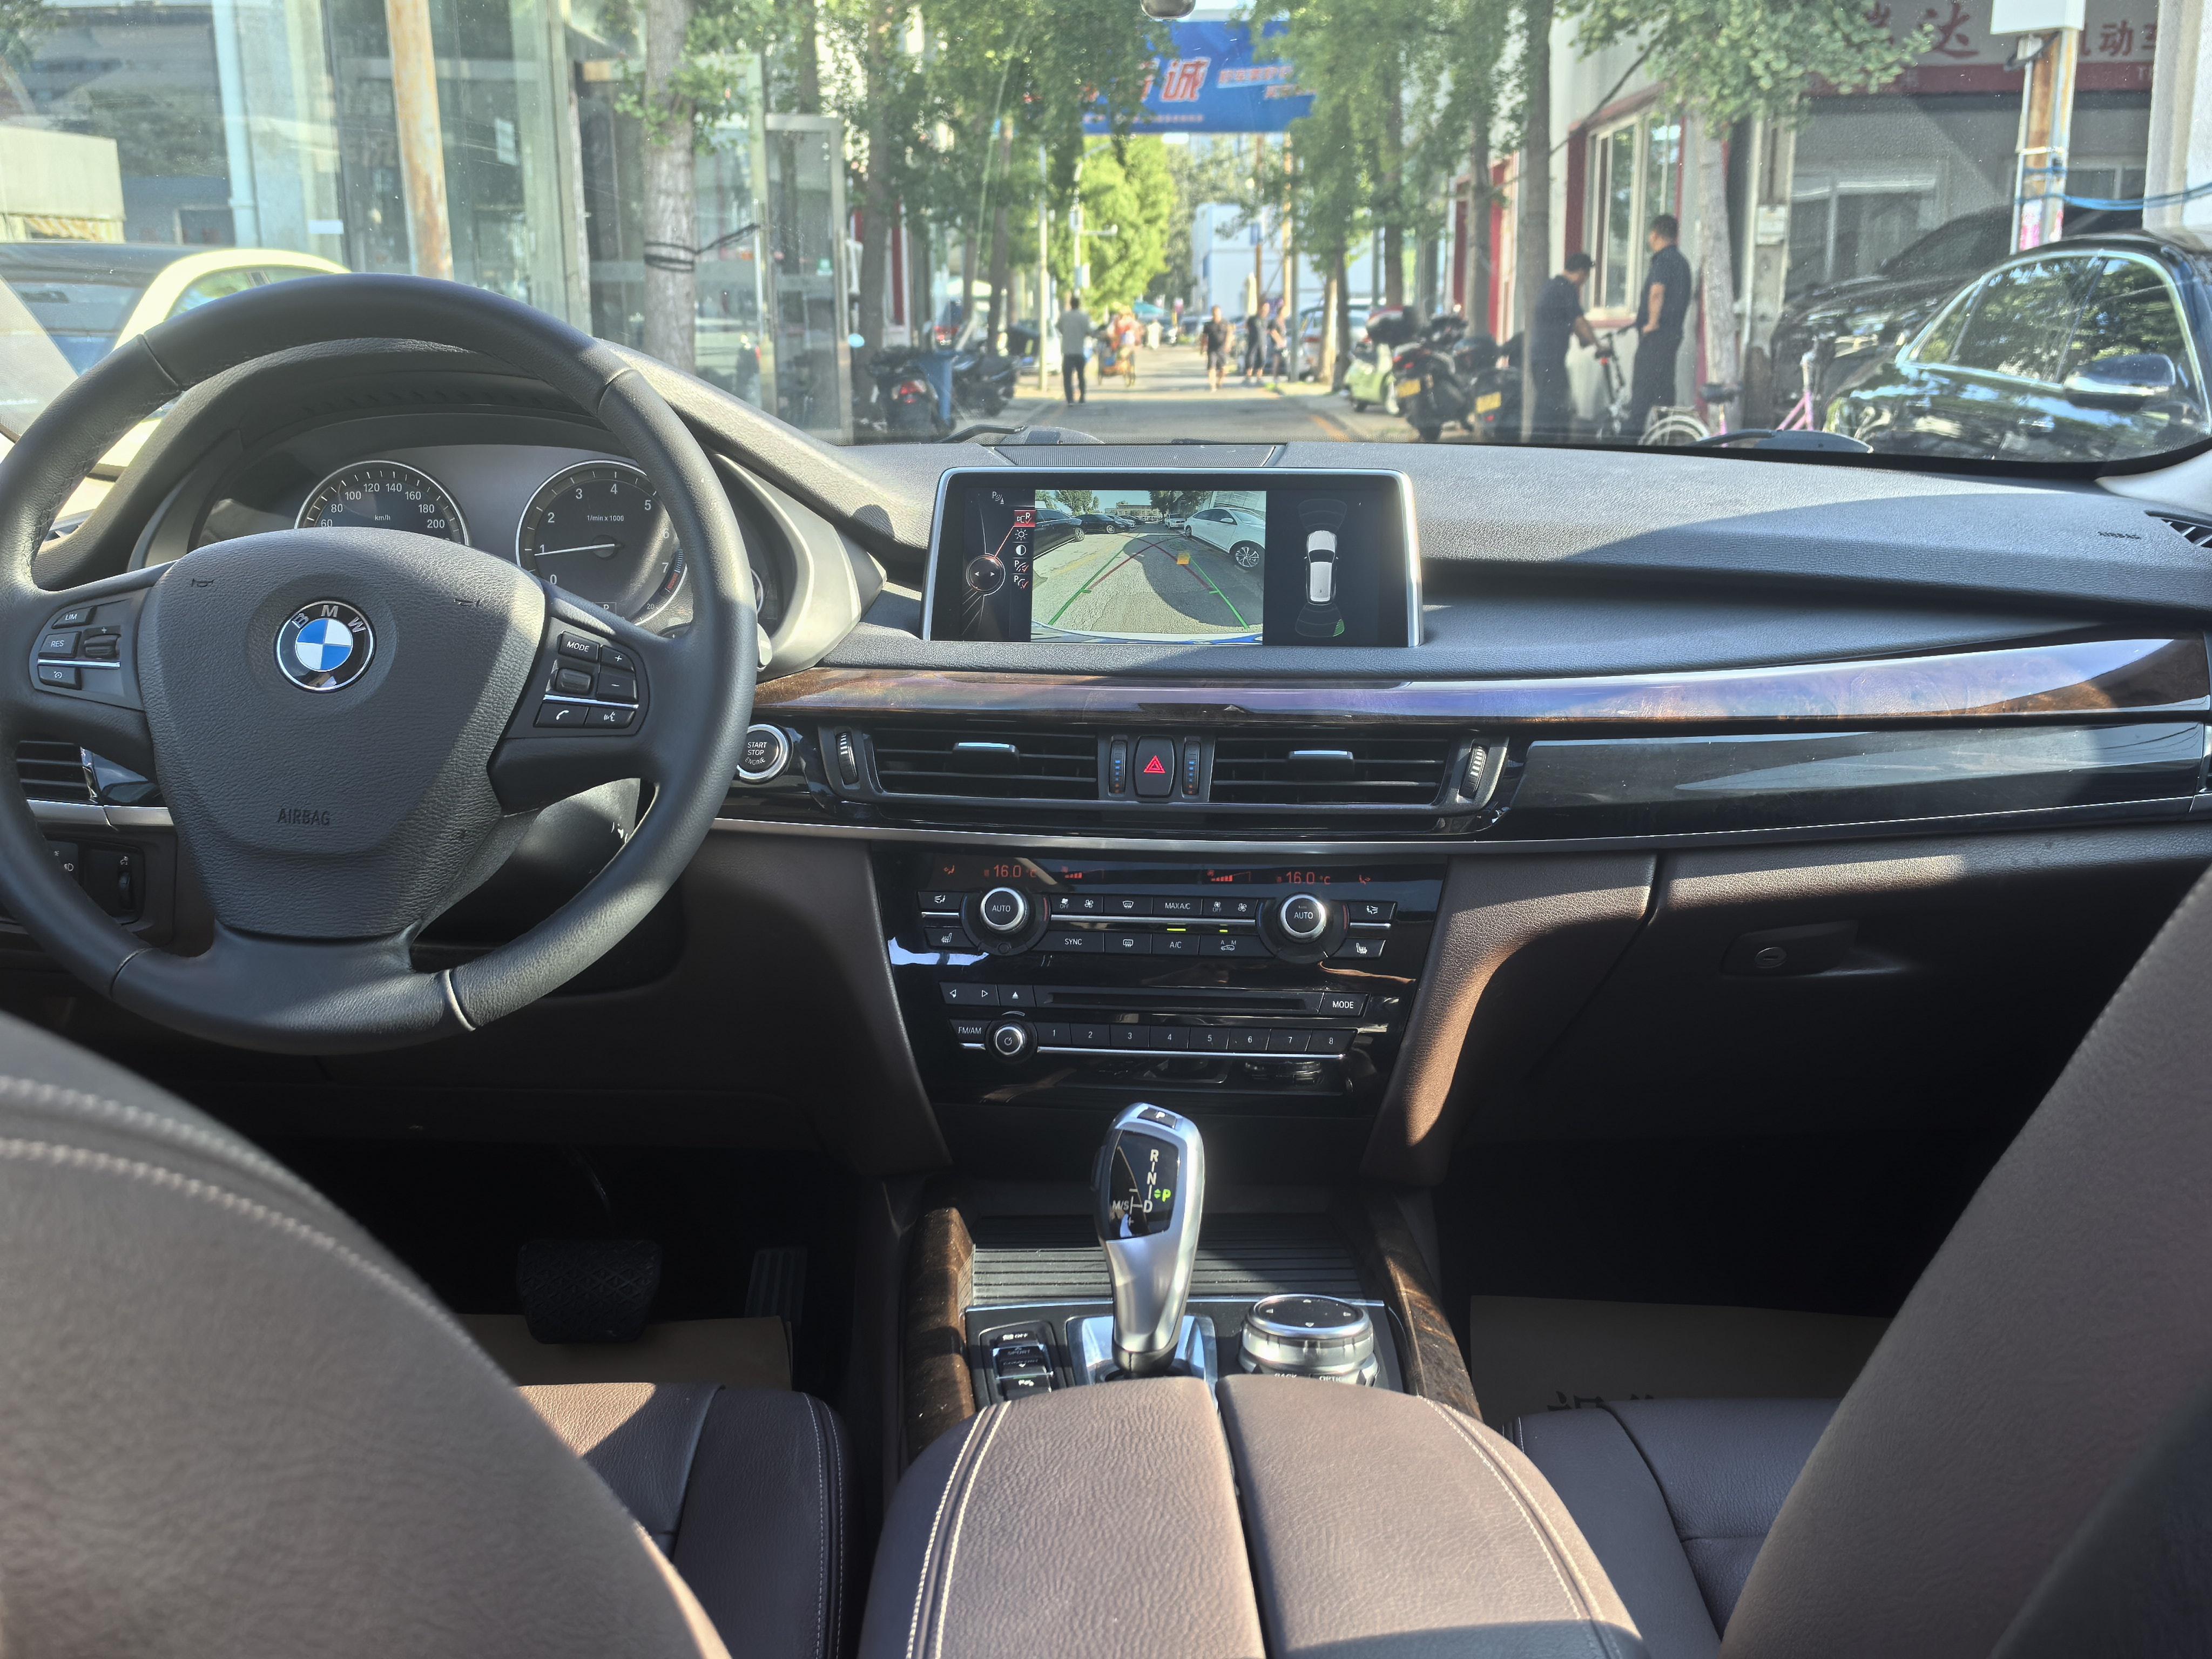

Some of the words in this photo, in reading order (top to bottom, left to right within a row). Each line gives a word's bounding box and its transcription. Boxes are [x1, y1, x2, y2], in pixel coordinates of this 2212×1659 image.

[363, 483, 380, 493] 120
[386, 483, 402, 493] 140
[610, 484, 617, 494] 4
[345, 491, 362, 500] 100
[404, 491, 421, 500] 160
[576, 489, 583, 499] 3
[331, 504, 343, 513] 80
[418, 504, 434, 513] 180
[645, 500, 651, 510] 5
[548, 512, 555, 523] 2
[321, 519, 333, 528] 60
[427, 520, 445, 529] 200
[539, 544, 545, 553] 1
[662, 563, 669, 573] 7
[550, 575, 557, 584] 0
[292, 604, 366, 633] BMW
[567, 641, 590, 652] MODE
[745, 757, 766, 766] ENGINE
[276, 808, 330, 826] AIRBAG
[958, 1026, 981, 1034] FM/AM
[1150, 1149, 1159, 1162] R
[1147, 1172, 1156, 1185] N
[1162, 1189, 1171, 1202] P
[1112, 1200, 1129, 1210] M/S
[1143, 1199, 1153, 1213] D
